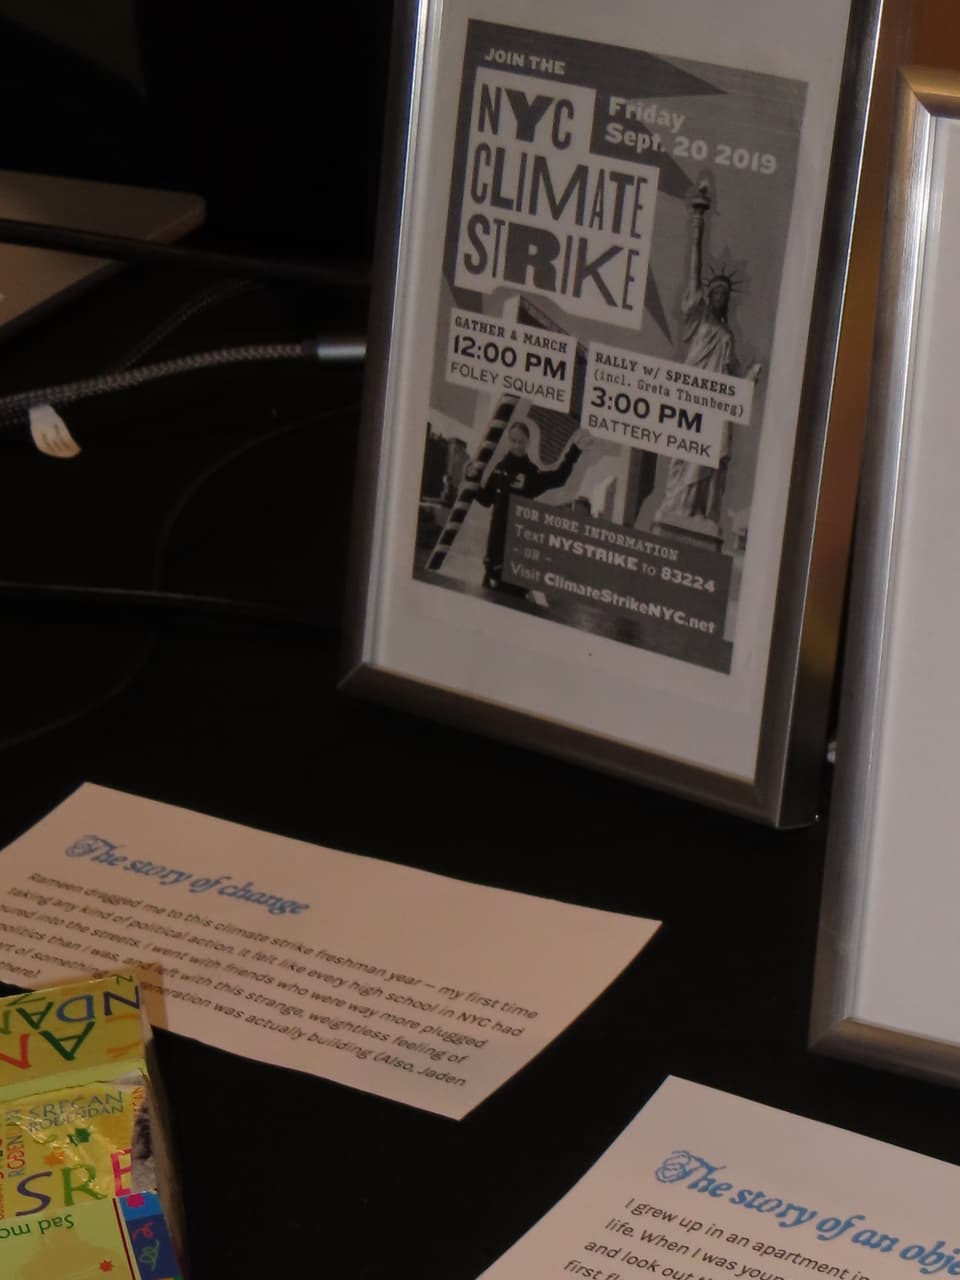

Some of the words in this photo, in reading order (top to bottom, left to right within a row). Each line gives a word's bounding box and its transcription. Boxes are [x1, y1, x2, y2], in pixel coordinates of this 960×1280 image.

[484, 48, 525, 67] JOIN
[528, 55, 566, 75] THE
[477, 83, 575, 151] NYC
[608, 97, 686, 133] Friday
[605, 122, 670, 155] Sept.
[672, 135, 708, 161] 20
[715, 144, 777, 175] 2019
[470, 142, 648, 239] CLIMATE
[463, 213, 640, 311] STRIKE
[453, 334, 518, 368] 12:00
[524, 352, 567, 381] PM
[454, 315, 505, 338] GATHER
[522, 332, 568, 354] MARCH
[450, 361, 499, 385] FOLEY
[503, 375, 566, 403] SQUARE
[593, 368, 632, 388] (incl.
[637, 378, 671, 398] Greta
[676, 387, 744, 418] Thunberg)
[594, 351, 638, 372] RALLY
[642, 365, 661, 380] w/
[665, 369, 736, 397] SPEAKERS
[587, 413, 663, 444] BATTERY
[666, 434, 711, 458] PARK
[590, 386, 650, 419] 3:00
[658, 403, 703, 434] PM
[514, 523, 545, 544] Text
[548, 534, 638, 571] NYSTRIKE
[641, 562, 657, 576] to
[660, 566, 715, 593] 83224
[515, 505, 540, 522] FOR
[544, 513, 579, 533] MORE
[584, 524, 679, 561] INFORMATION
[543, 572, 715, 634] ClimateStrikeNYC.net
[64, 833, 129, 867] The
[122, 859, 194, 886] story
[188, 875, 233, 895] of
[217, 880, 311, 916] change
[654, 1149, 733, 1198] The
[728, 1189, 818, 1229] story
[815, 1214, 867, 1242] of
[851, 1229, 900, 1253] an
[604, 1217, 635, 1238] life.
[639, 1228, 690, 1256] When
[690, 1247, 702, 1259] I
[701, 1252, 739, 1271] was
[624, 1197, 636, 1209] I
[630, 1203, 679, 1223] grew
[678, 1217, 704, 1233] up
[704, 1223, 725, 1240] in
[725, 1233, 750, 1248] an
[751, 1241, 850, 1280] apartment
